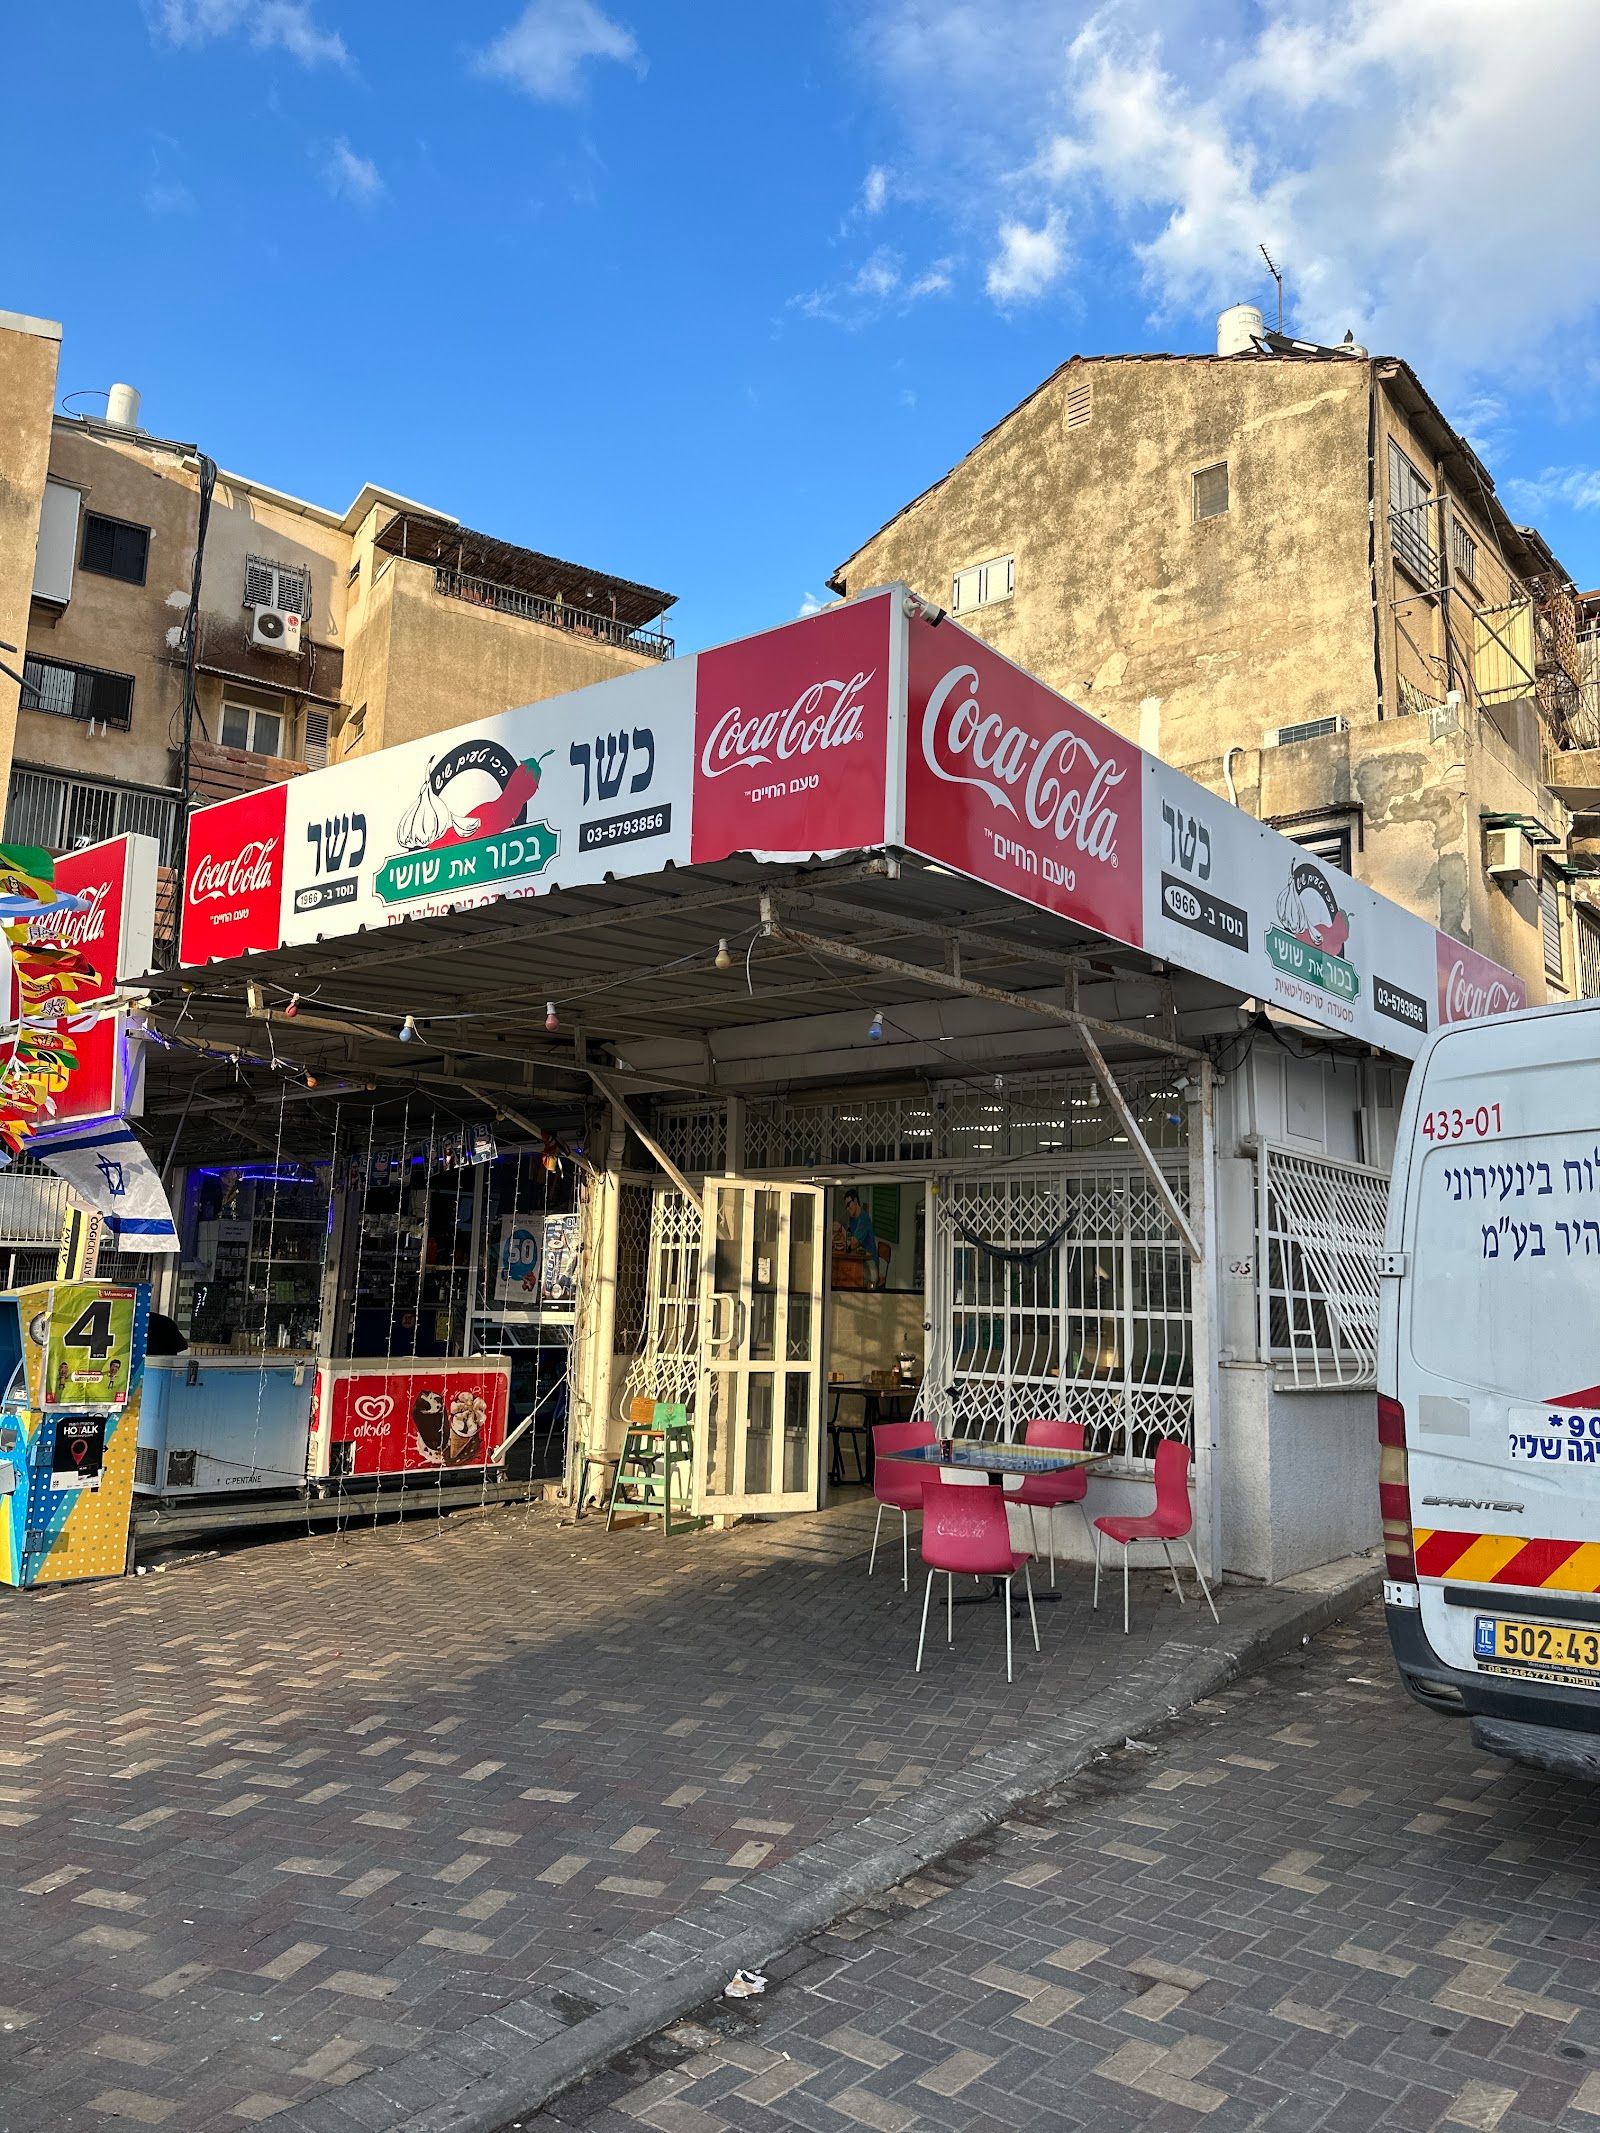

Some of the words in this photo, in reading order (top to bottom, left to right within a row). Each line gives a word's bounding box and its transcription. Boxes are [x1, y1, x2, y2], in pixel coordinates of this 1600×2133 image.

[701, 667, 877, 778] Coca-Cola
[456, 748, 491, 772] טעים
[490, 756, 509, 777] הכי
[569, 725, 655, 807] כשר
[921, 664, 1128, 863] Coca-Cola
[435, 763, 453, 790] שיש
[789, 774, 820, 794] טעם
[307, 811, 367, 877] כשר
[586, 812, 663, 844] 03-5793856
[1162, 798, 1211, 881] כשר
[448, 855, 477, 879] את
[486, 836, 542, 870] בכור
[994, 832, 1038, 875] החיים
[189, 835, 280, 905] Coca-Cola
[389, 857, 441, 891] שושי
[1042, 856, 1076, 892] טעם
[300, 894, 319, 906] 1966
[335, 884, 355, 897] נוסד
[1170, 889, 1196, 917] 1966
[233, 908, 250, 921] טעם
[1219, 911, 1244, 938] נוסד
[1274, 936, 1304, 968] שושי
[1308, 958, 1324, 978] את
[1326, 961, 1353, 992] בכור
[1274, 977, 1324, 1009] טריפוליטאית
[1377, 987, 1423, 1024] 03-5793856
[1327, 1001, 1354, 1023] מסעדה
[1422, 1102, 1502, 1141] 433-01
[1444, 1160, 1553, 1203] בינעירוני
[61, 1228, 71, 1265] ATM
[84, 1257, 93, 1276] ATM
[64, 1301, 115, 1359] 4
[1508, 1433, 1562, 1460] שלי?
[1421, 1495, 1525, 1514] SPRINTER
[1481, 1629, 1492, 1645] IL
